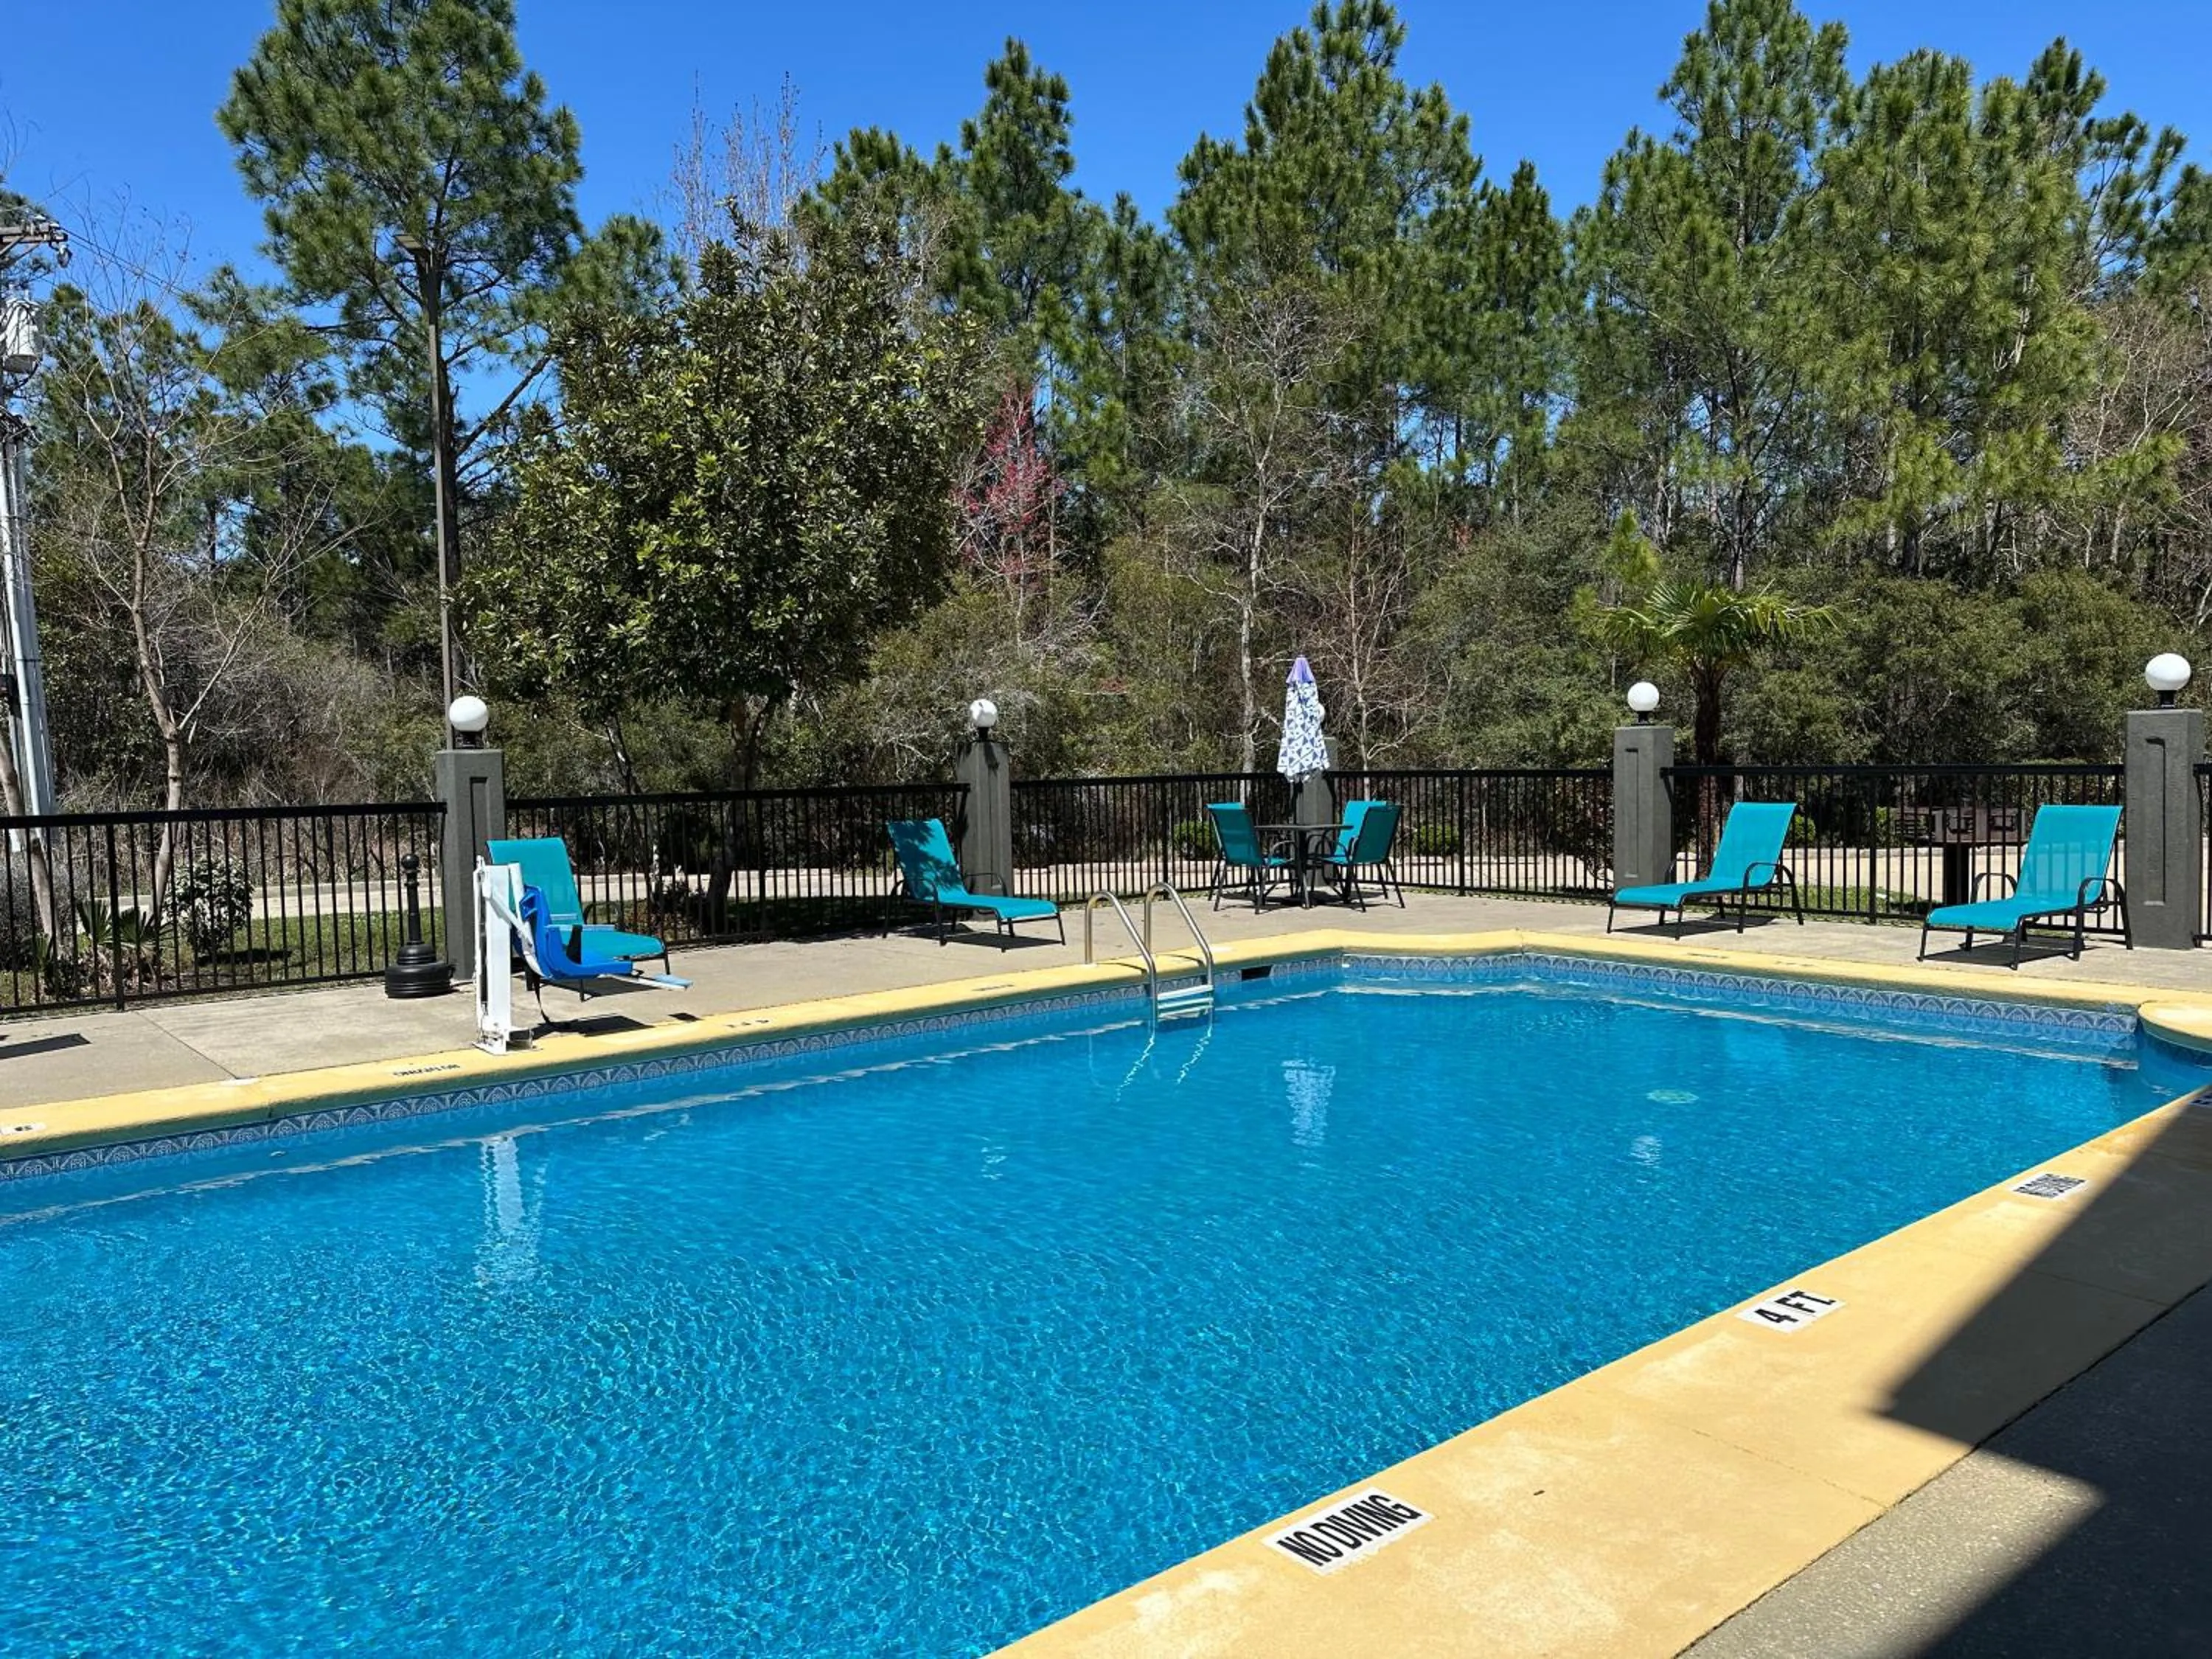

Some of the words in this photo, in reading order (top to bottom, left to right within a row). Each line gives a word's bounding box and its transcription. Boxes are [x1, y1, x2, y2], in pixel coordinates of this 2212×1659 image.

[1754, 1309, 1798, 1324] 4
[1277, 1531, 1343, 1566] NO
[1310, 1495, 1423, 1549] DIVING
